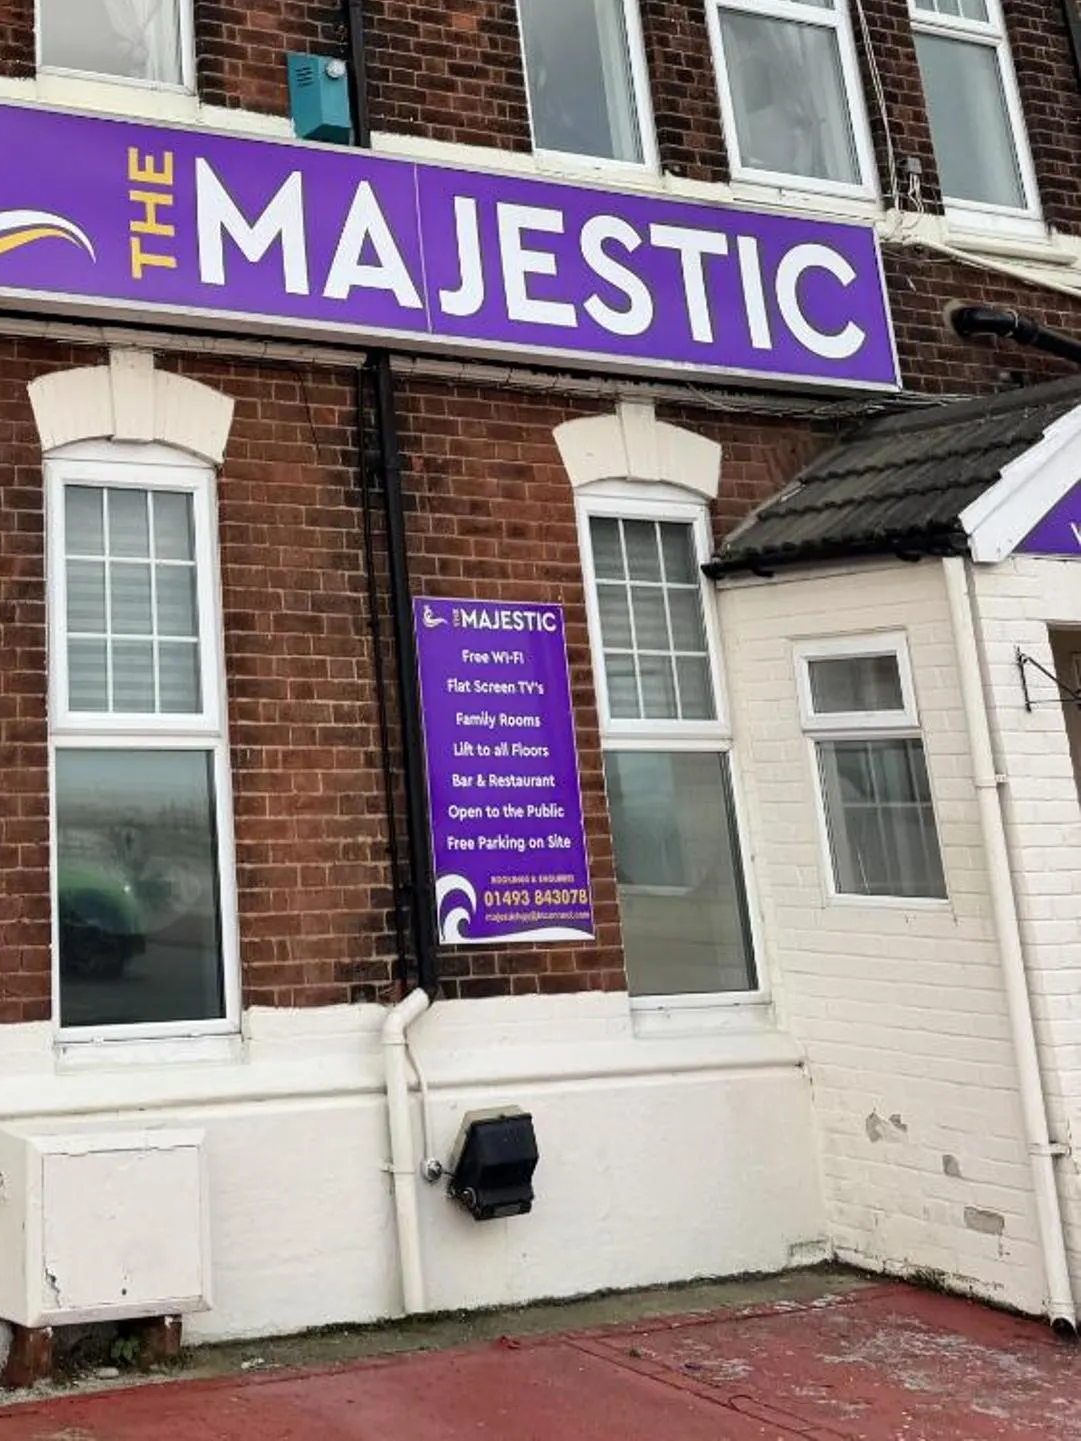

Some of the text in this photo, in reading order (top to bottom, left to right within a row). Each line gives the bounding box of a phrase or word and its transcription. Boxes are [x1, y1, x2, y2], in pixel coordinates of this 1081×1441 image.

[128, 147, 178, 280] THE
[195, 157, 866, 359] MAJESTIC
[460, 608, 557, 632] MAJESTIC
[461, 649, 490, 664] Free
[447, 677, 472, 693] Flat
[473, 679, 516, 694] Screen
[455, 710, 541, 730] Family Rooms
[453, 741, 550, 758] Lift to all Floors
[451, 773, 556, 788] Bar & Restaurant
[448, 802, 565, 822] Open to the Public
[446, 833, 572, 853] Free Parking on Site
[483, 888, 588, 907] 01493 843078
